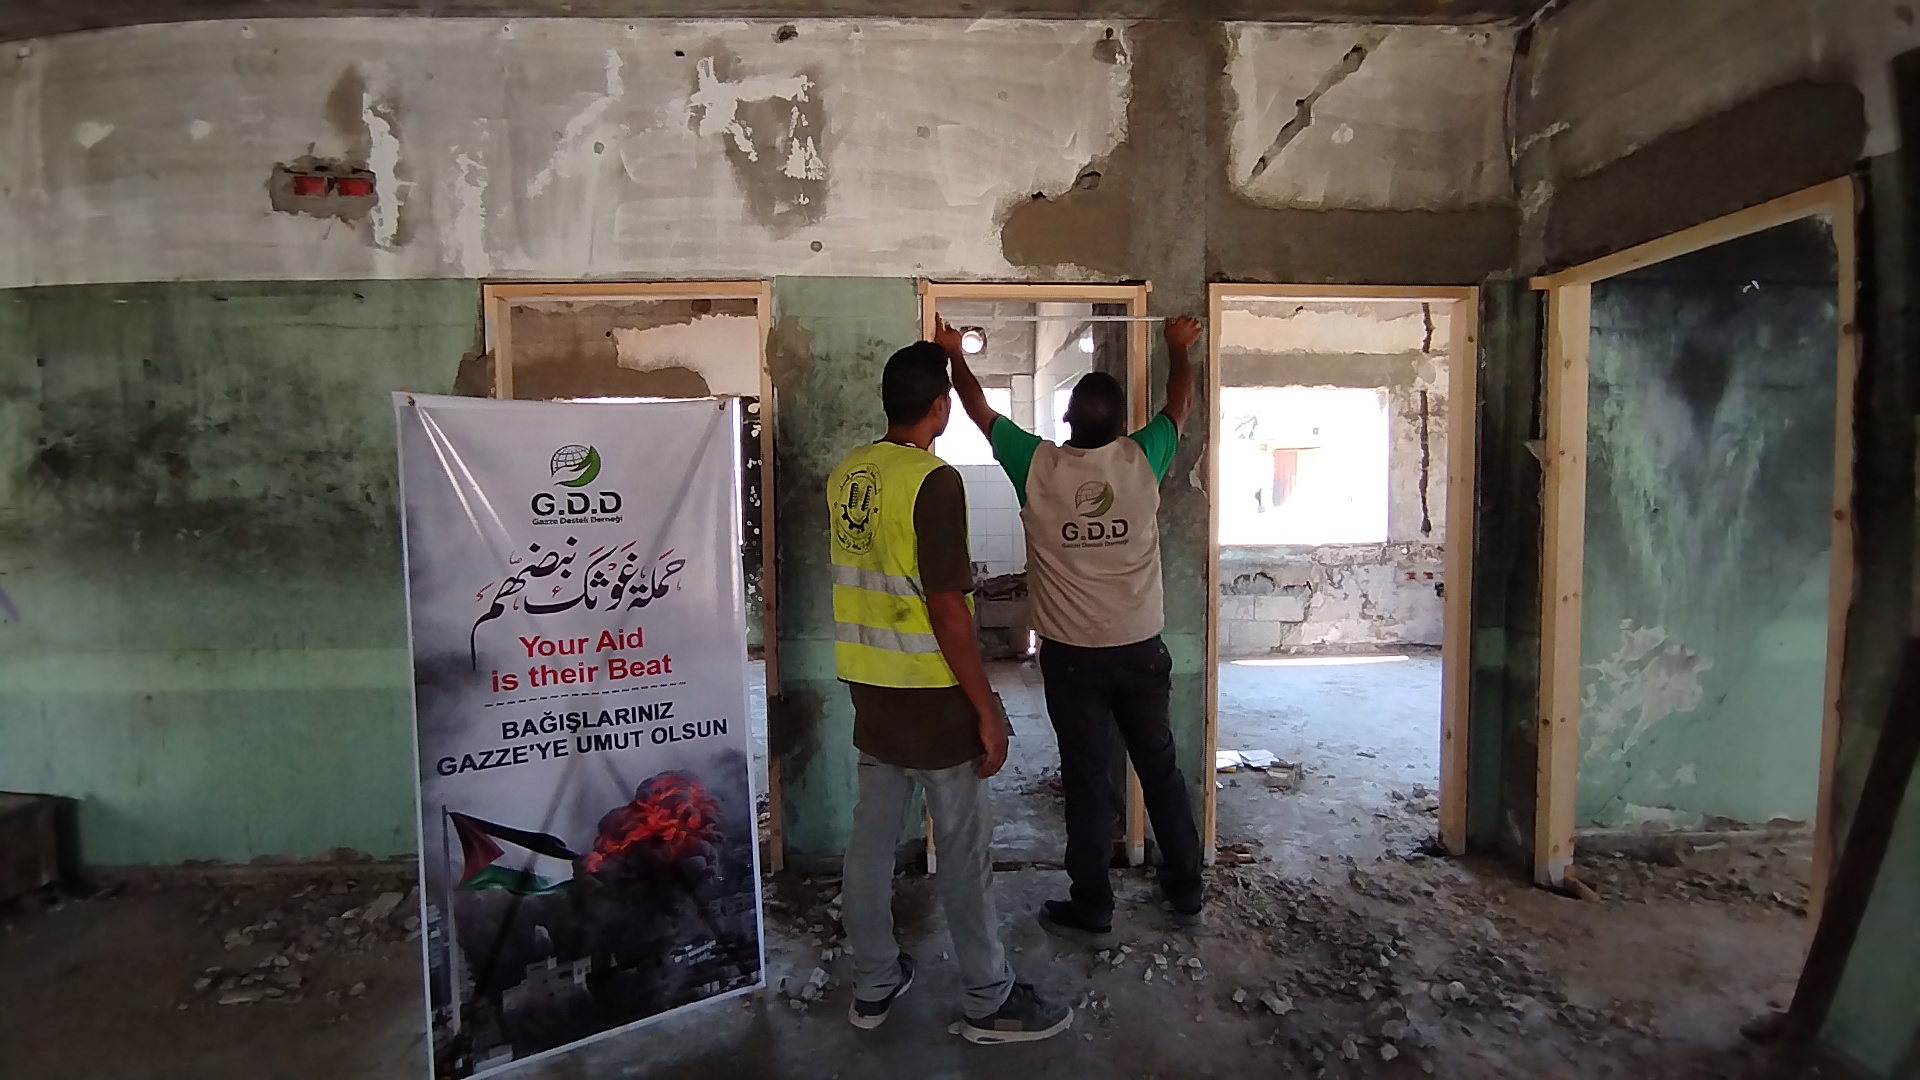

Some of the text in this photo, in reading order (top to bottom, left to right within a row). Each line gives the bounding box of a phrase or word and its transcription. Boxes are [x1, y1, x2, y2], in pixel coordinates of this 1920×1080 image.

[531, 491, 622, 516] G.D.D
[1062, 519, 1128, 541] G.D.D
[519, 627, 643, 658] Your Aid
[492, 654, 672, 692] is their Beat
[502, 702, 674, 740] BAĞIŞLARINIZ
[436, 718, 728, 777] GAZZE'YE UMUT OLSUN
